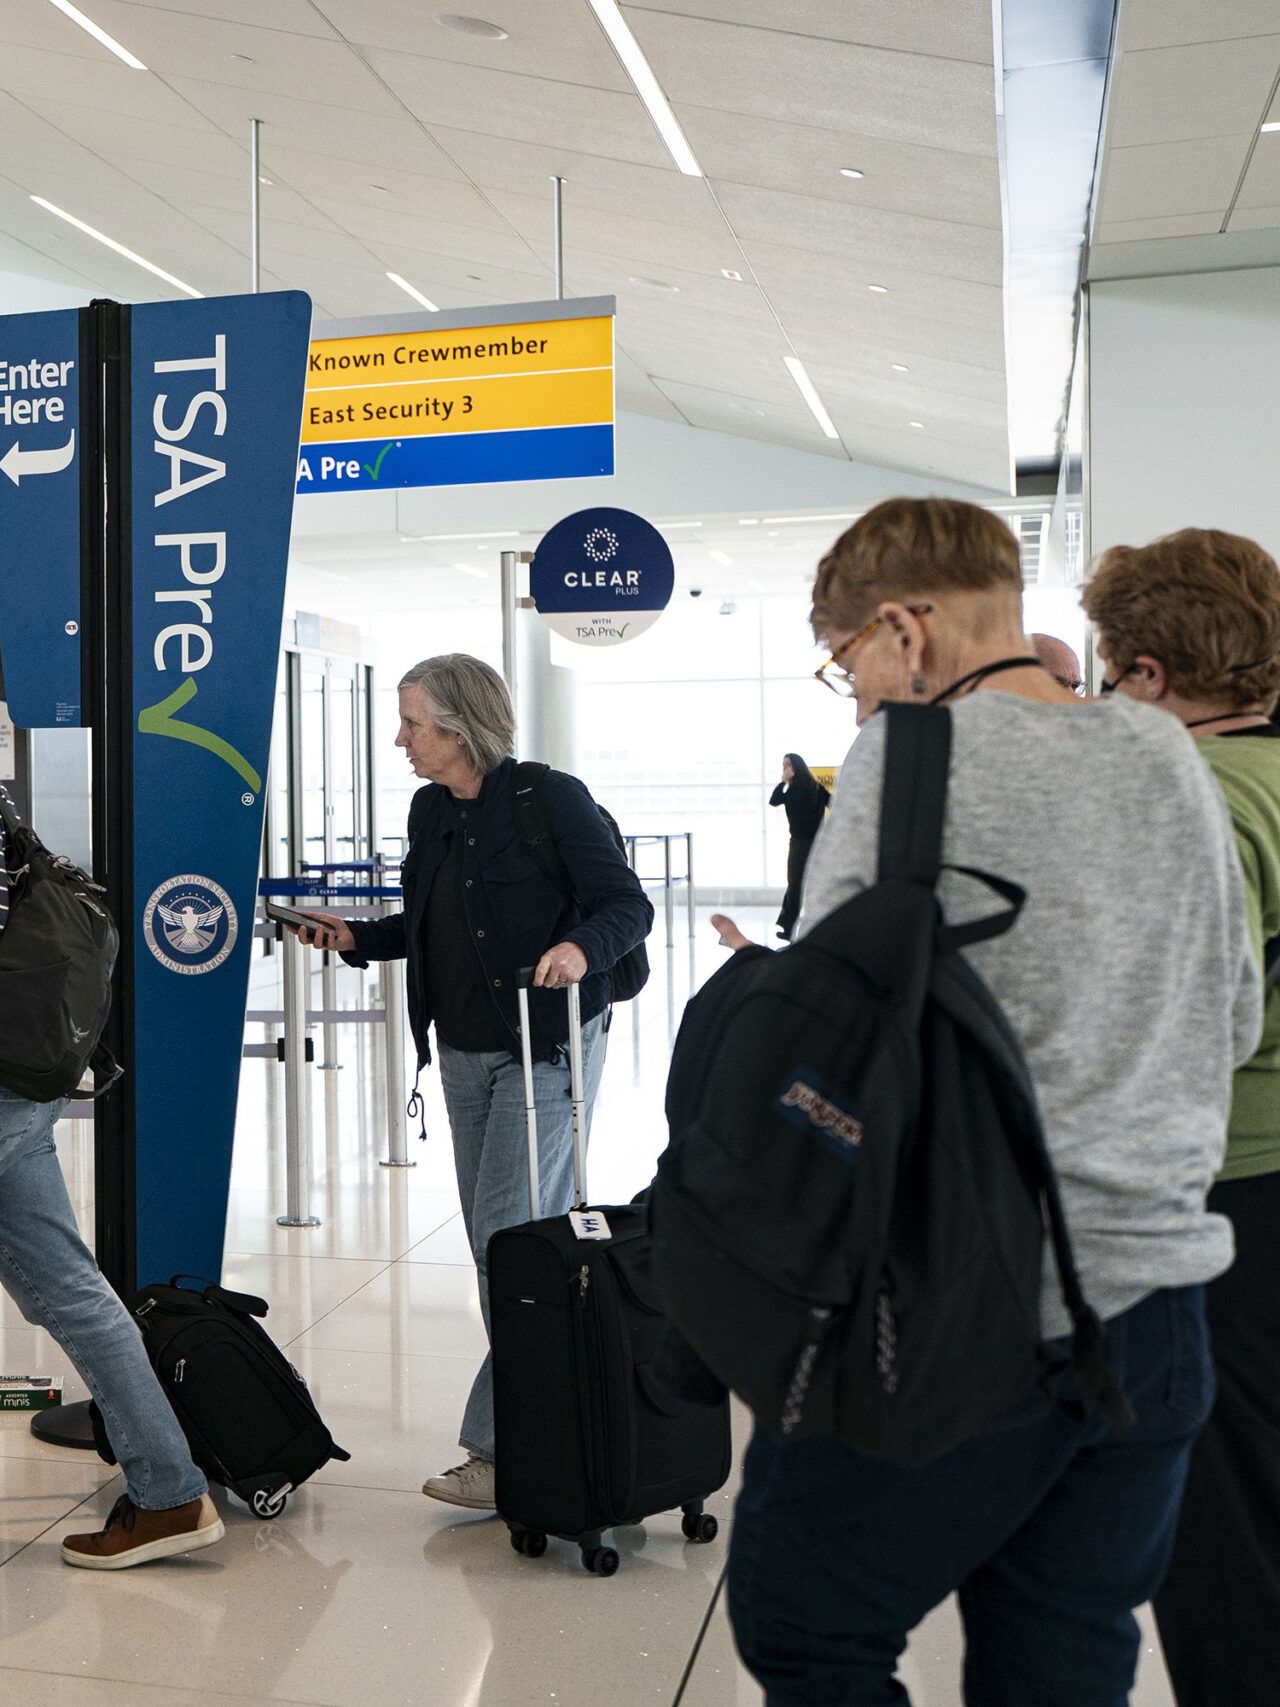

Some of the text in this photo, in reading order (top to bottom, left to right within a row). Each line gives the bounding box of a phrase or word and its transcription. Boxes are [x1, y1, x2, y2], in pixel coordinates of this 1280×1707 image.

[309, 336, 549, 372] Known Crewmember
[154, 334, 228, 508] TSA
[310, 395, 474, 425] East Security 3
[564, 571, 640, 588] CLEAR
[615, 586, 640, 595] PLUS
[576, 627, 595, 638] TSA
[144, 875, 238, 932] TRANSPORTATION SECURITY
[149, 944, 230, 975] ADMINISTRATION
[4, 1398, 31, 1407] minis
